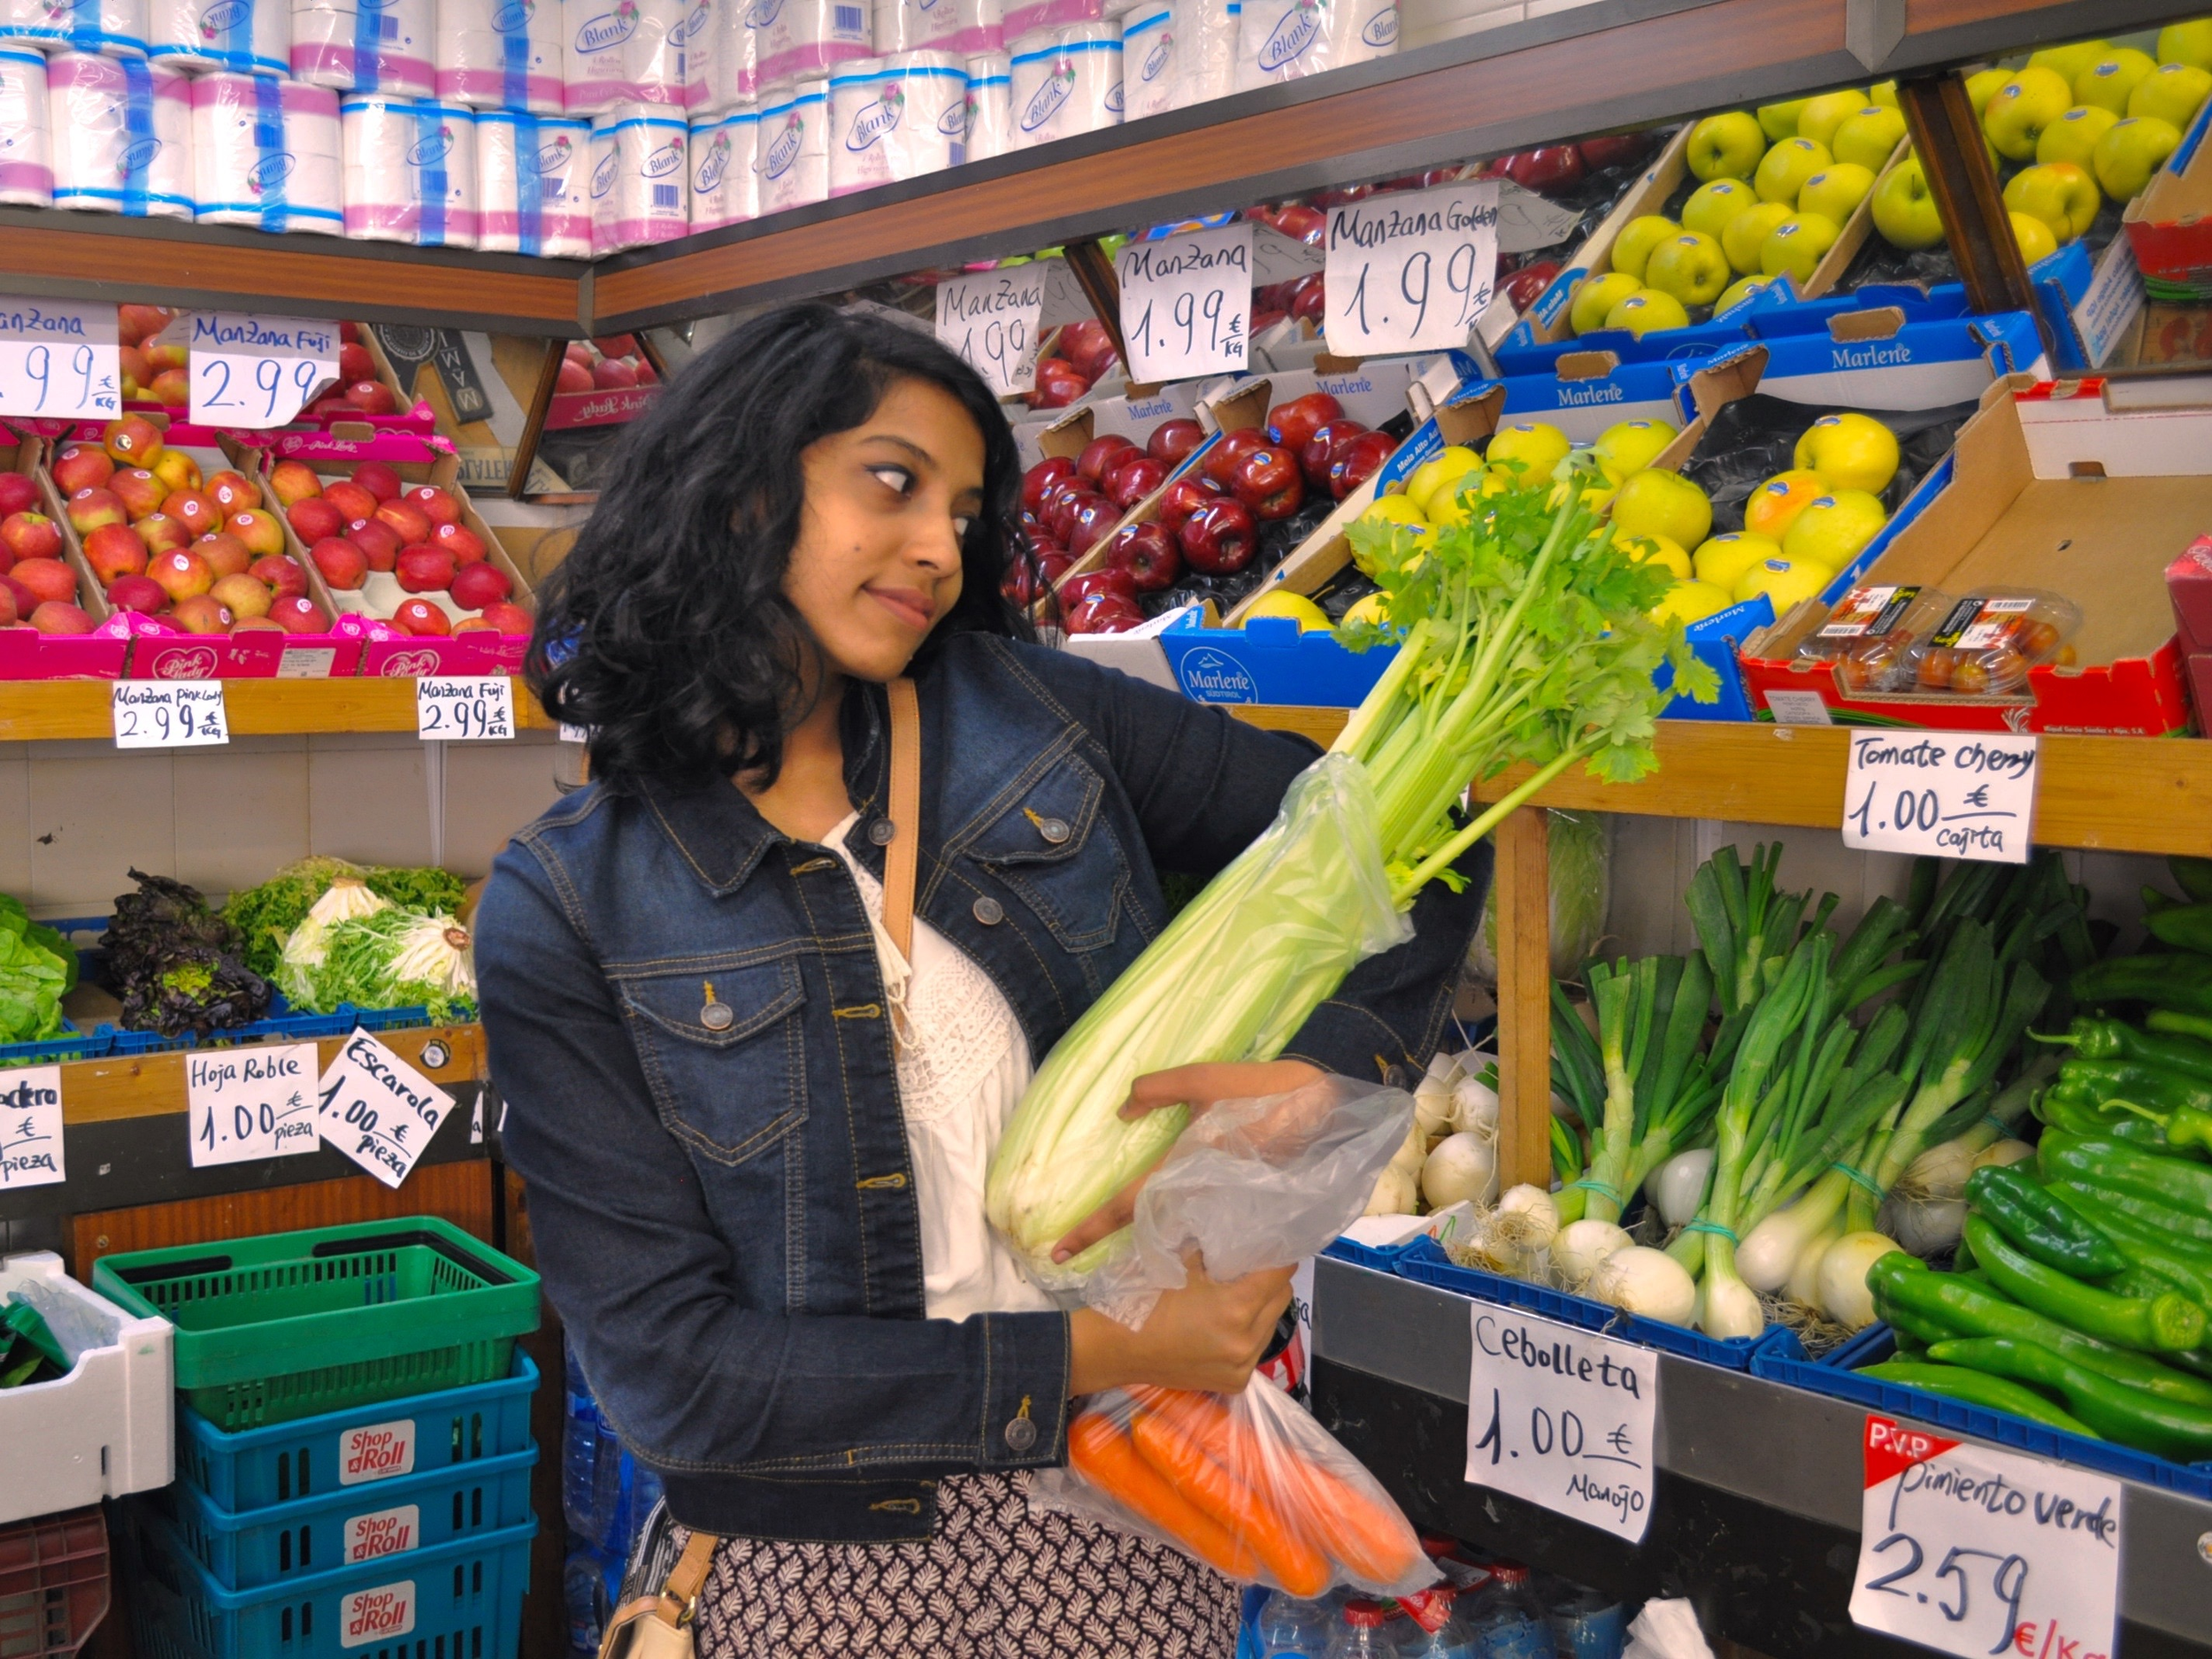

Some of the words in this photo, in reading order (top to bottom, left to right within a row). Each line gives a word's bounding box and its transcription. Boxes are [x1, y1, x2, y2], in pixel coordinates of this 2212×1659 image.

[209, 4, 242, 26] Blank
[499, 10, 528, 29] Blank
[584, 18, 629, 47] Blank
[1271, 12, 1313, 60] Blank
[1147, 50, 1169, 75] Blank
[1030, 81, 1063, 122] Blank
[856, 105, 895, 143] Blank
[127, 143, 157, 165] Blank
[416, 139, 447, 164] Blank
[537, 149, 565, 170] Blank
[649, 150, 680, 175] Blank
[768, 133, 798, 172] Blank
[257, 158, 288, 180] Blank
[1331, 211, 1443, 252] Manzana
[1123, 244, 1248, 288] Manzana
[1344, 243, 1476, 339] 1.99
[1131, 289, 1225, 357] 1.99
[203, 359, 317, 419] 2.99
[1694, 605, 1746, 632] Marlene
[161, 654, 203, 675] Pink
[114, 685, 173, 708] Manzana
[419, 682, 474, 701] Manzana
[479, 683, 505, 701] Fuji
[120, 704, 195, 741] 2.99
[421, 699, 487, 738] 2.99
[1855, 737, 1947, 770] Tomate
[1848, 780, 1939, 838] 1.00
[1962, 783, 1990, 808] €
[191, 1059, 237, 1093] Hoja
[242, 1055, 302, 1083] Roble
[346, 1035, 440, 1131] Escarola
[286, 1090, 303, 1107] €
[319, 1074, 379, 1133] 1.00
[15, 1116, 35, 1138] €
[199, 1103, 276, 1152] 1.00
[274, 1121, 313, 1150] pieza
[0, 1153, 58, 1183] pieza
[355, 1133, 407, 1179] pieza
[1475, 1316, 1640, 1400] Cebolleta
[1475, 1387, 1584, 1465] 1.00
[1606, 1423, 1632, 1455] €
[350, 1430, 394, 1455] Shop
[362, 1440, 406, 1471] Roll
[1565, 1474, 1646, 1524] Manojo
[356, 1517, 397, 1541] Shop
[2034, 1492, 2116, 1549] verde
[367, 1525, 411, 1557] Roll
[351, 1592, 395, 1617] Shop
[1864, 1532, 2029, 1656] 2.59
[364, 1600, 407, 1633] Roll
